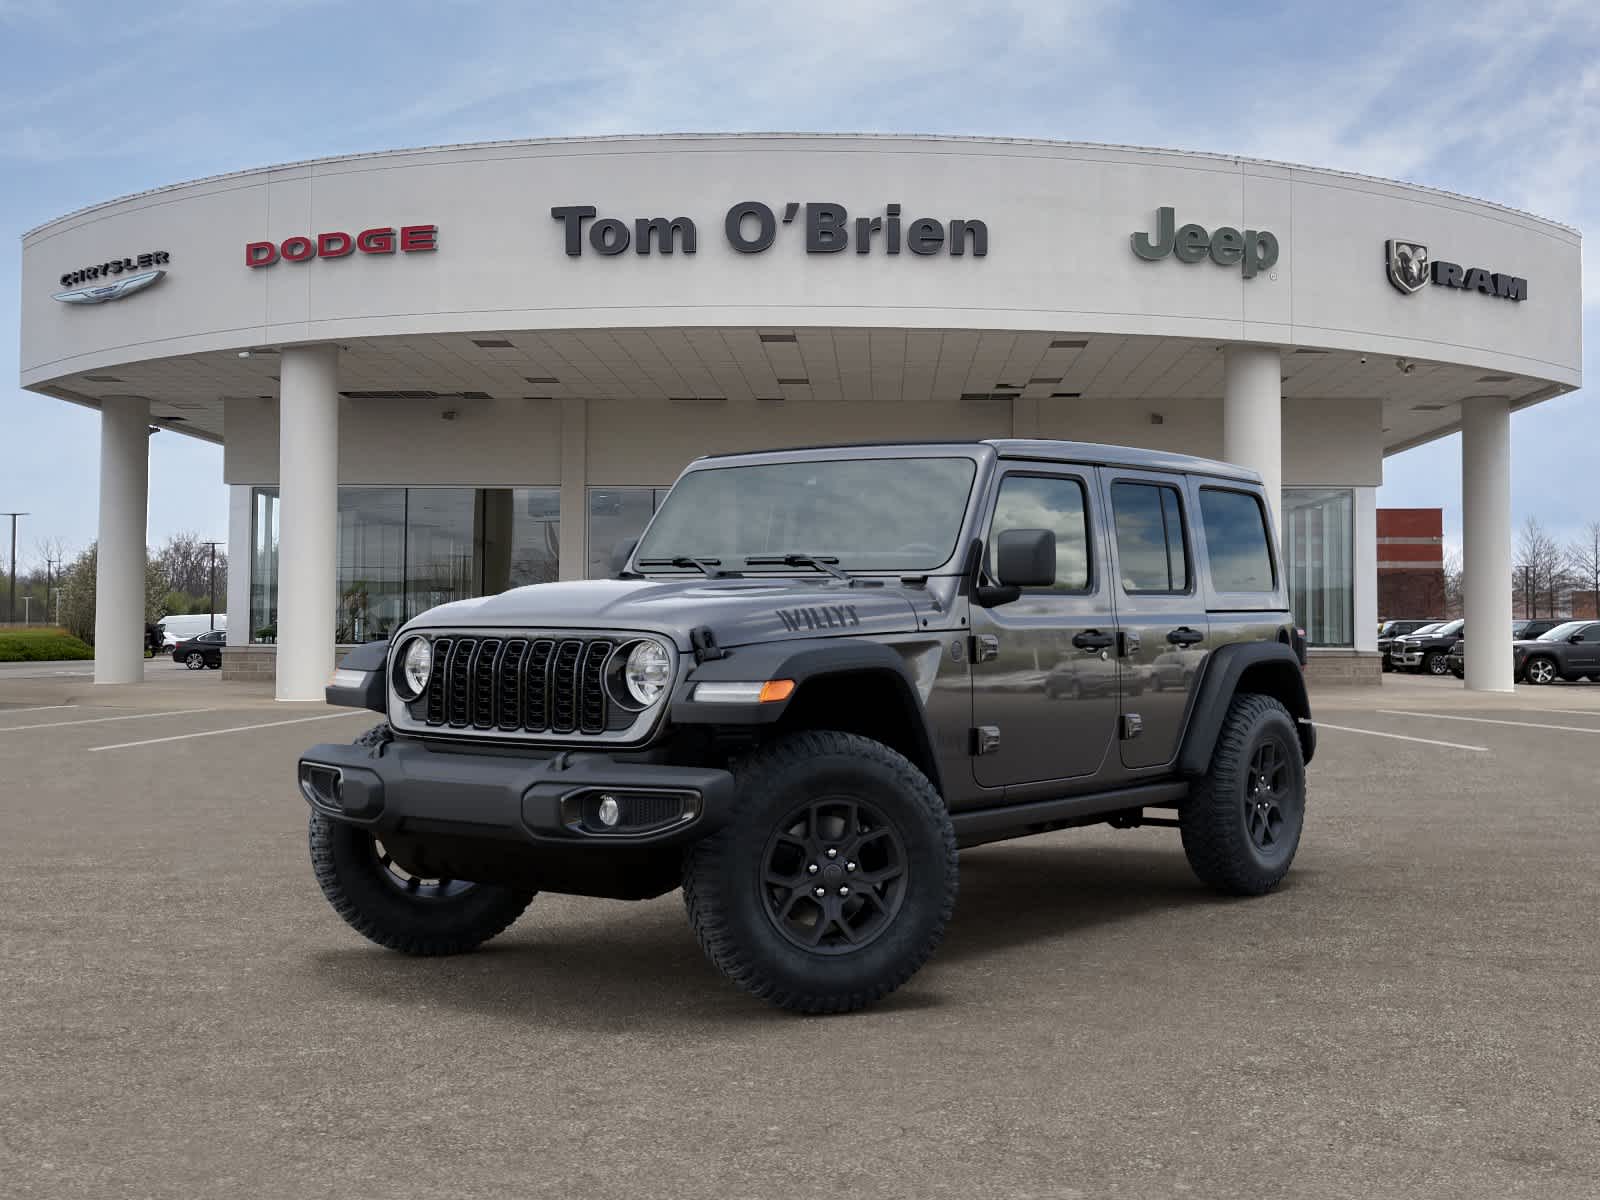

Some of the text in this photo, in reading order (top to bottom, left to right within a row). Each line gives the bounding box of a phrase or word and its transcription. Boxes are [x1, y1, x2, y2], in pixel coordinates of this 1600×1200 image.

[246, 224, 438, 269] DODGE
[551, 200, 988, 256] Tom O'Brien
[1130, 206, 1279, 279] Jeep
[60, 249, 170, 288] CHRYSLER
[1431, 260, 1528, 302] RAM
[776, 604, 860, 632] WILLYS
